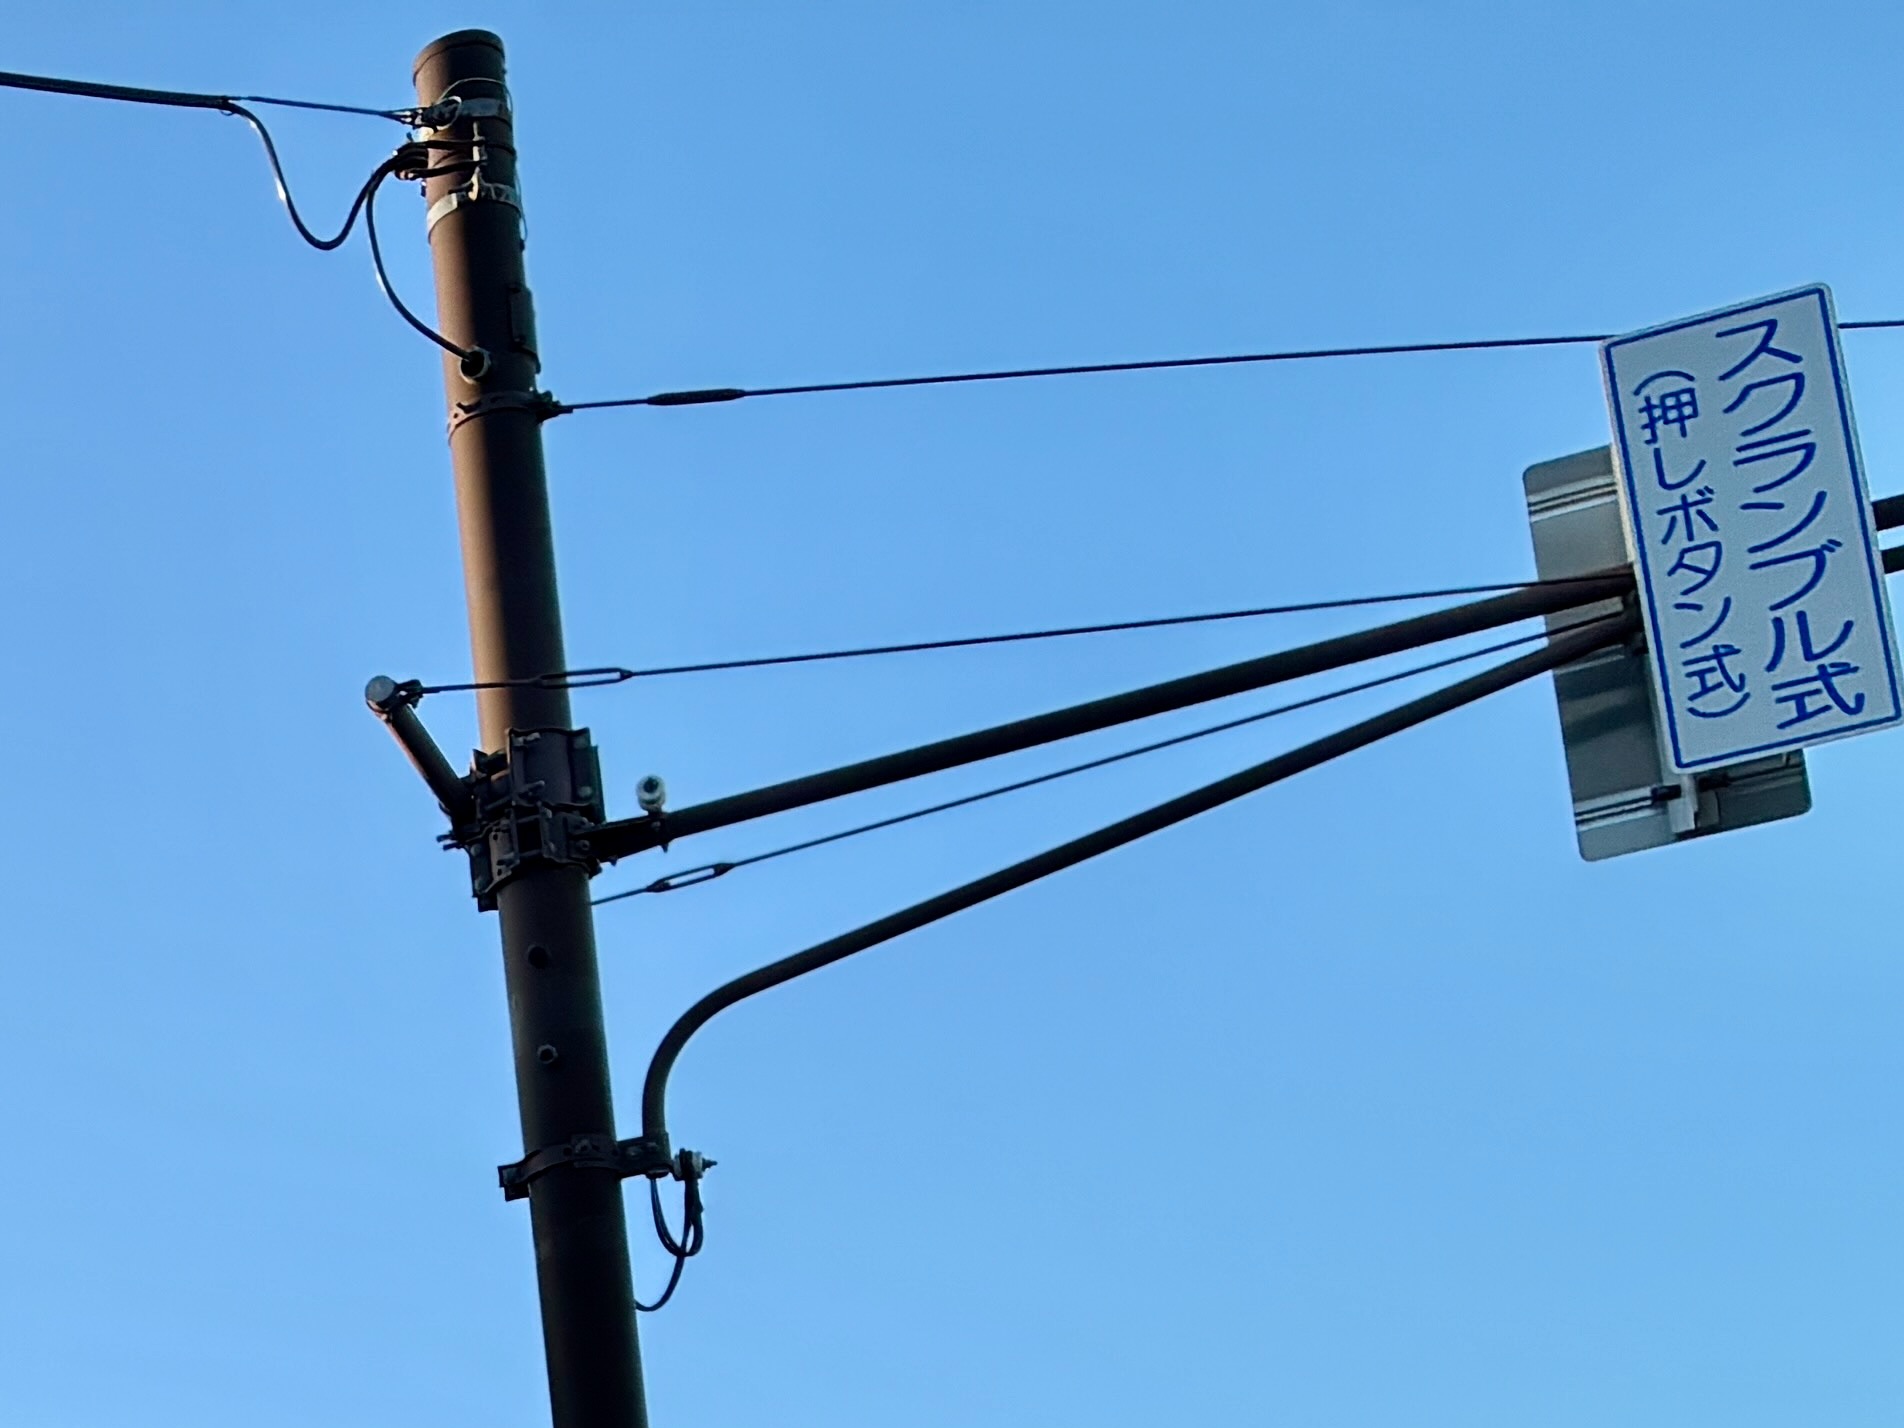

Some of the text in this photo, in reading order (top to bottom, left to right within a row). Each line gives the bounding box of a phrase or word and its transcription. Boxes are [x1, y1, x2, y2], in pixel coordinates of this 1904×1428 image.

[1633, 369, 1751, 718] （押しボタン式）
[1716, 318, 1865, 730] スクランブル式
